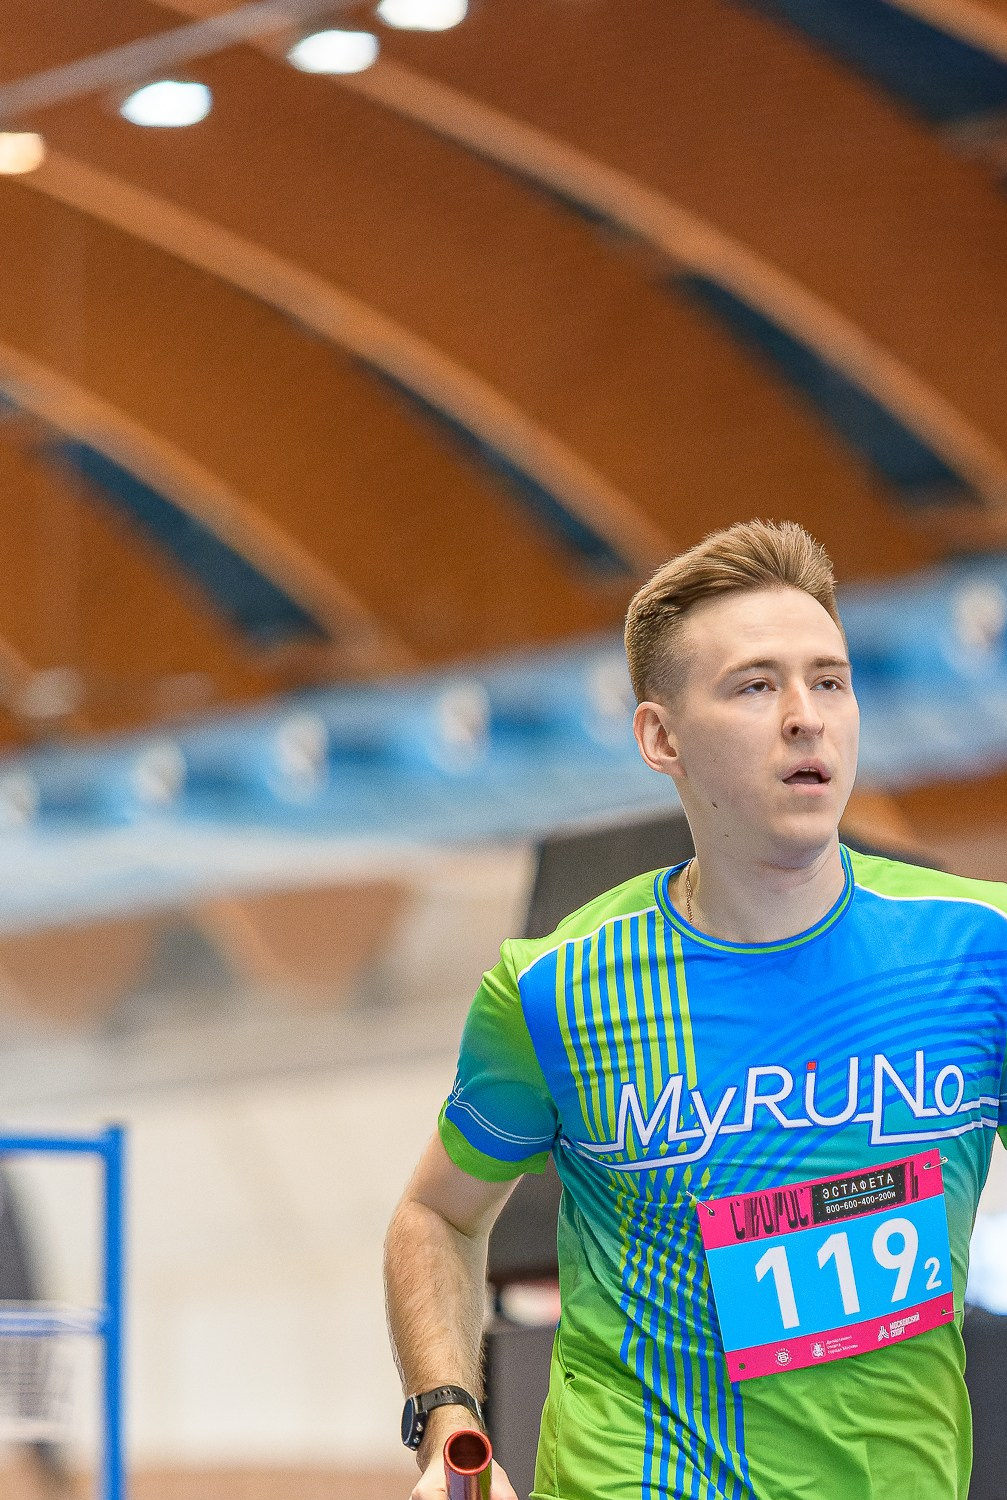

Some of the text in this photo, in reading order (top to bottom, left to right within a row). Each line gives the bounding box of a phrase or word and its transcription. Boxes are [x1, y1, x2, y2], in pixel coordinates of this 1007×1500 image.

[822, 1173, 895, 1200] ЭСТАФЕТА
[754, 1217, 942, 1330] 119 2
